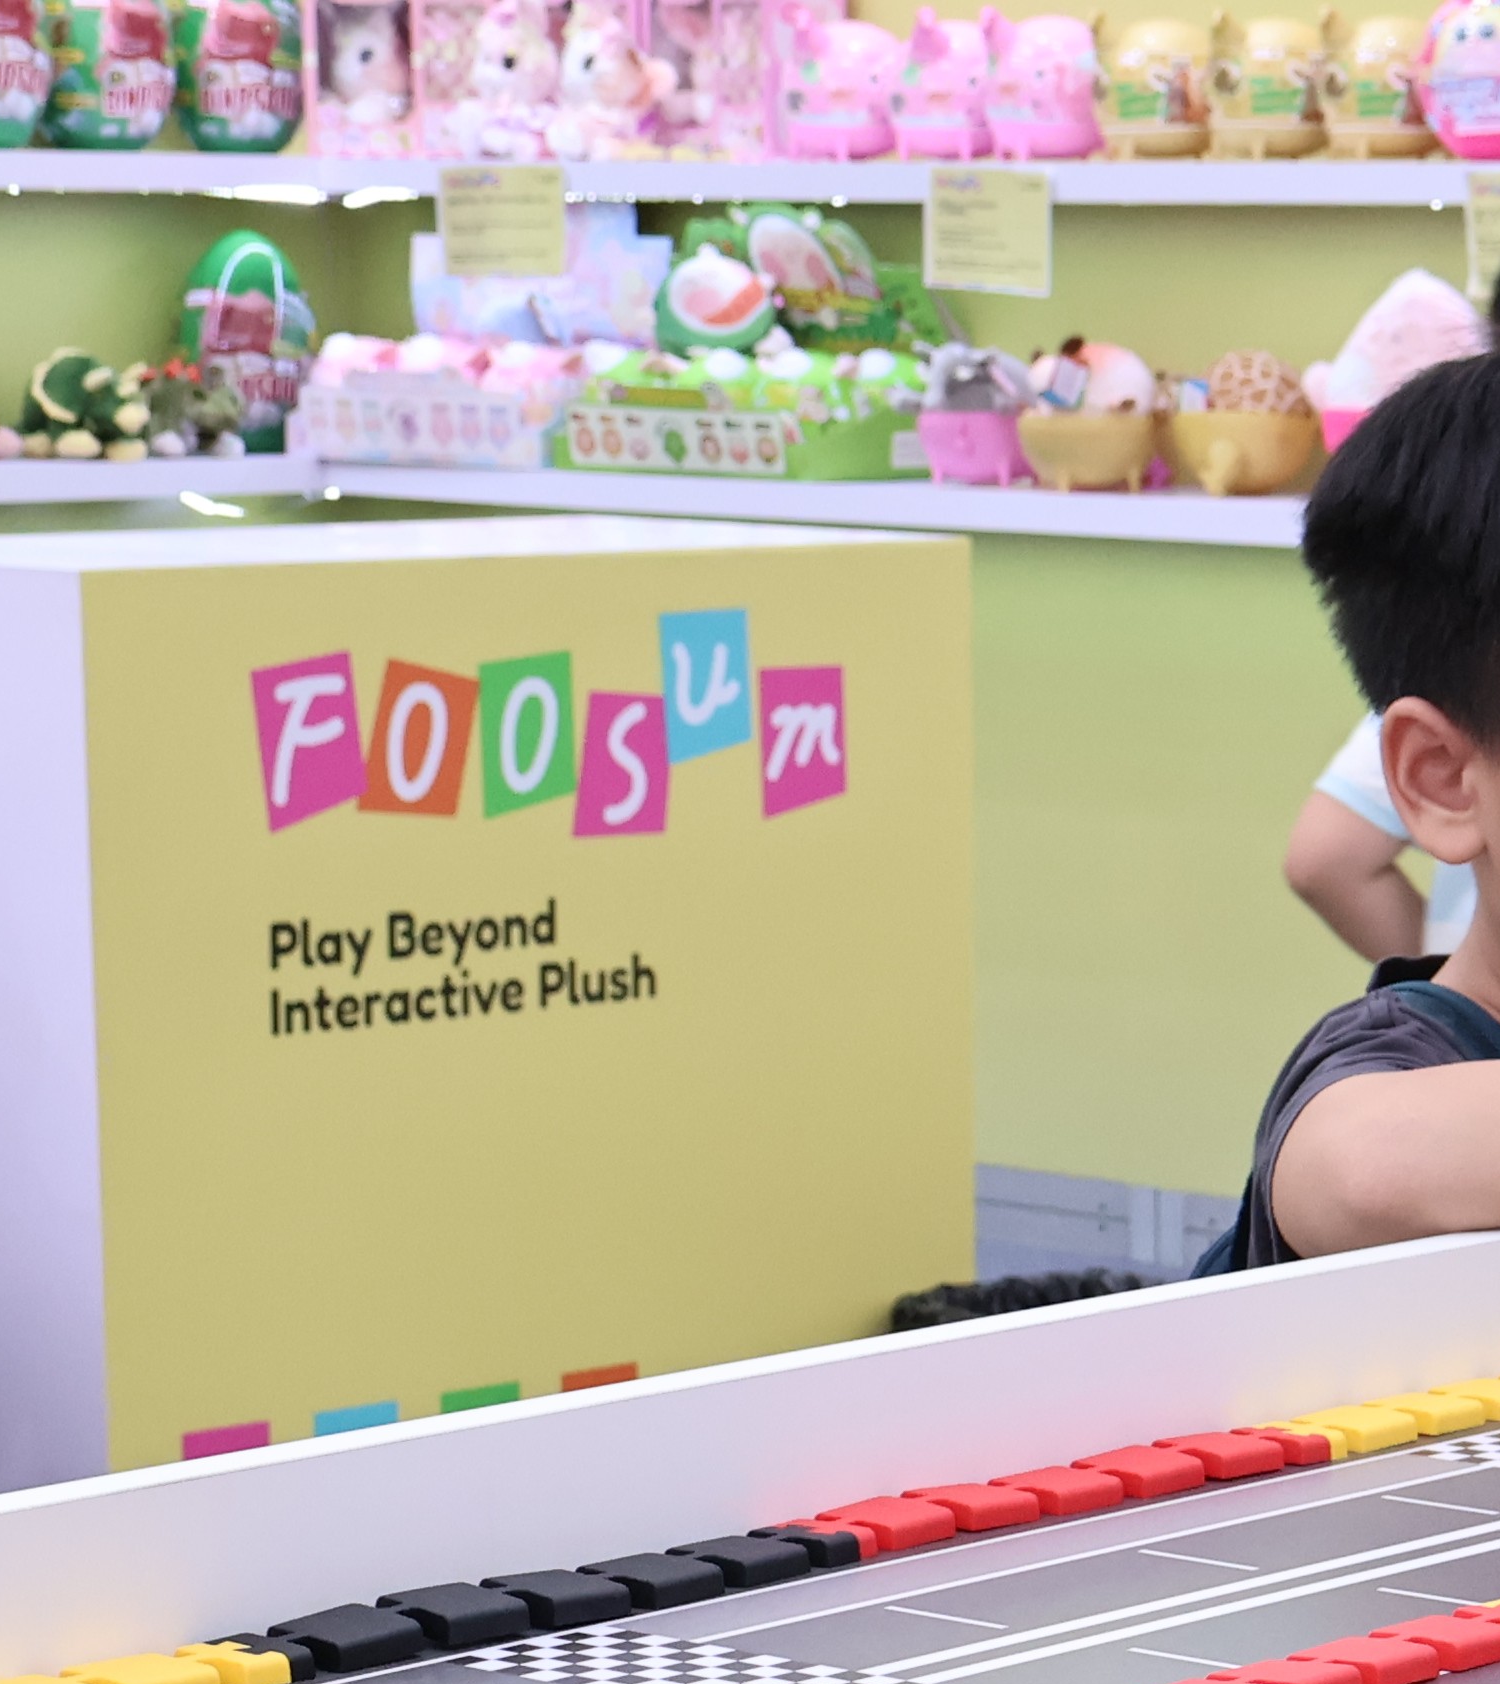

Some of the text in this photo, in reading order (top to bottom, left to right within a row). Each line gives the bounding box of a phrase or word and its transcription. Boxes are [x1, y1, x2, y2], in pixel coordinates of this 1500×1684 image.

[270, 897, 557, 975] Play Beyond
[270, 953, 657, 1036] Interactive Plush
